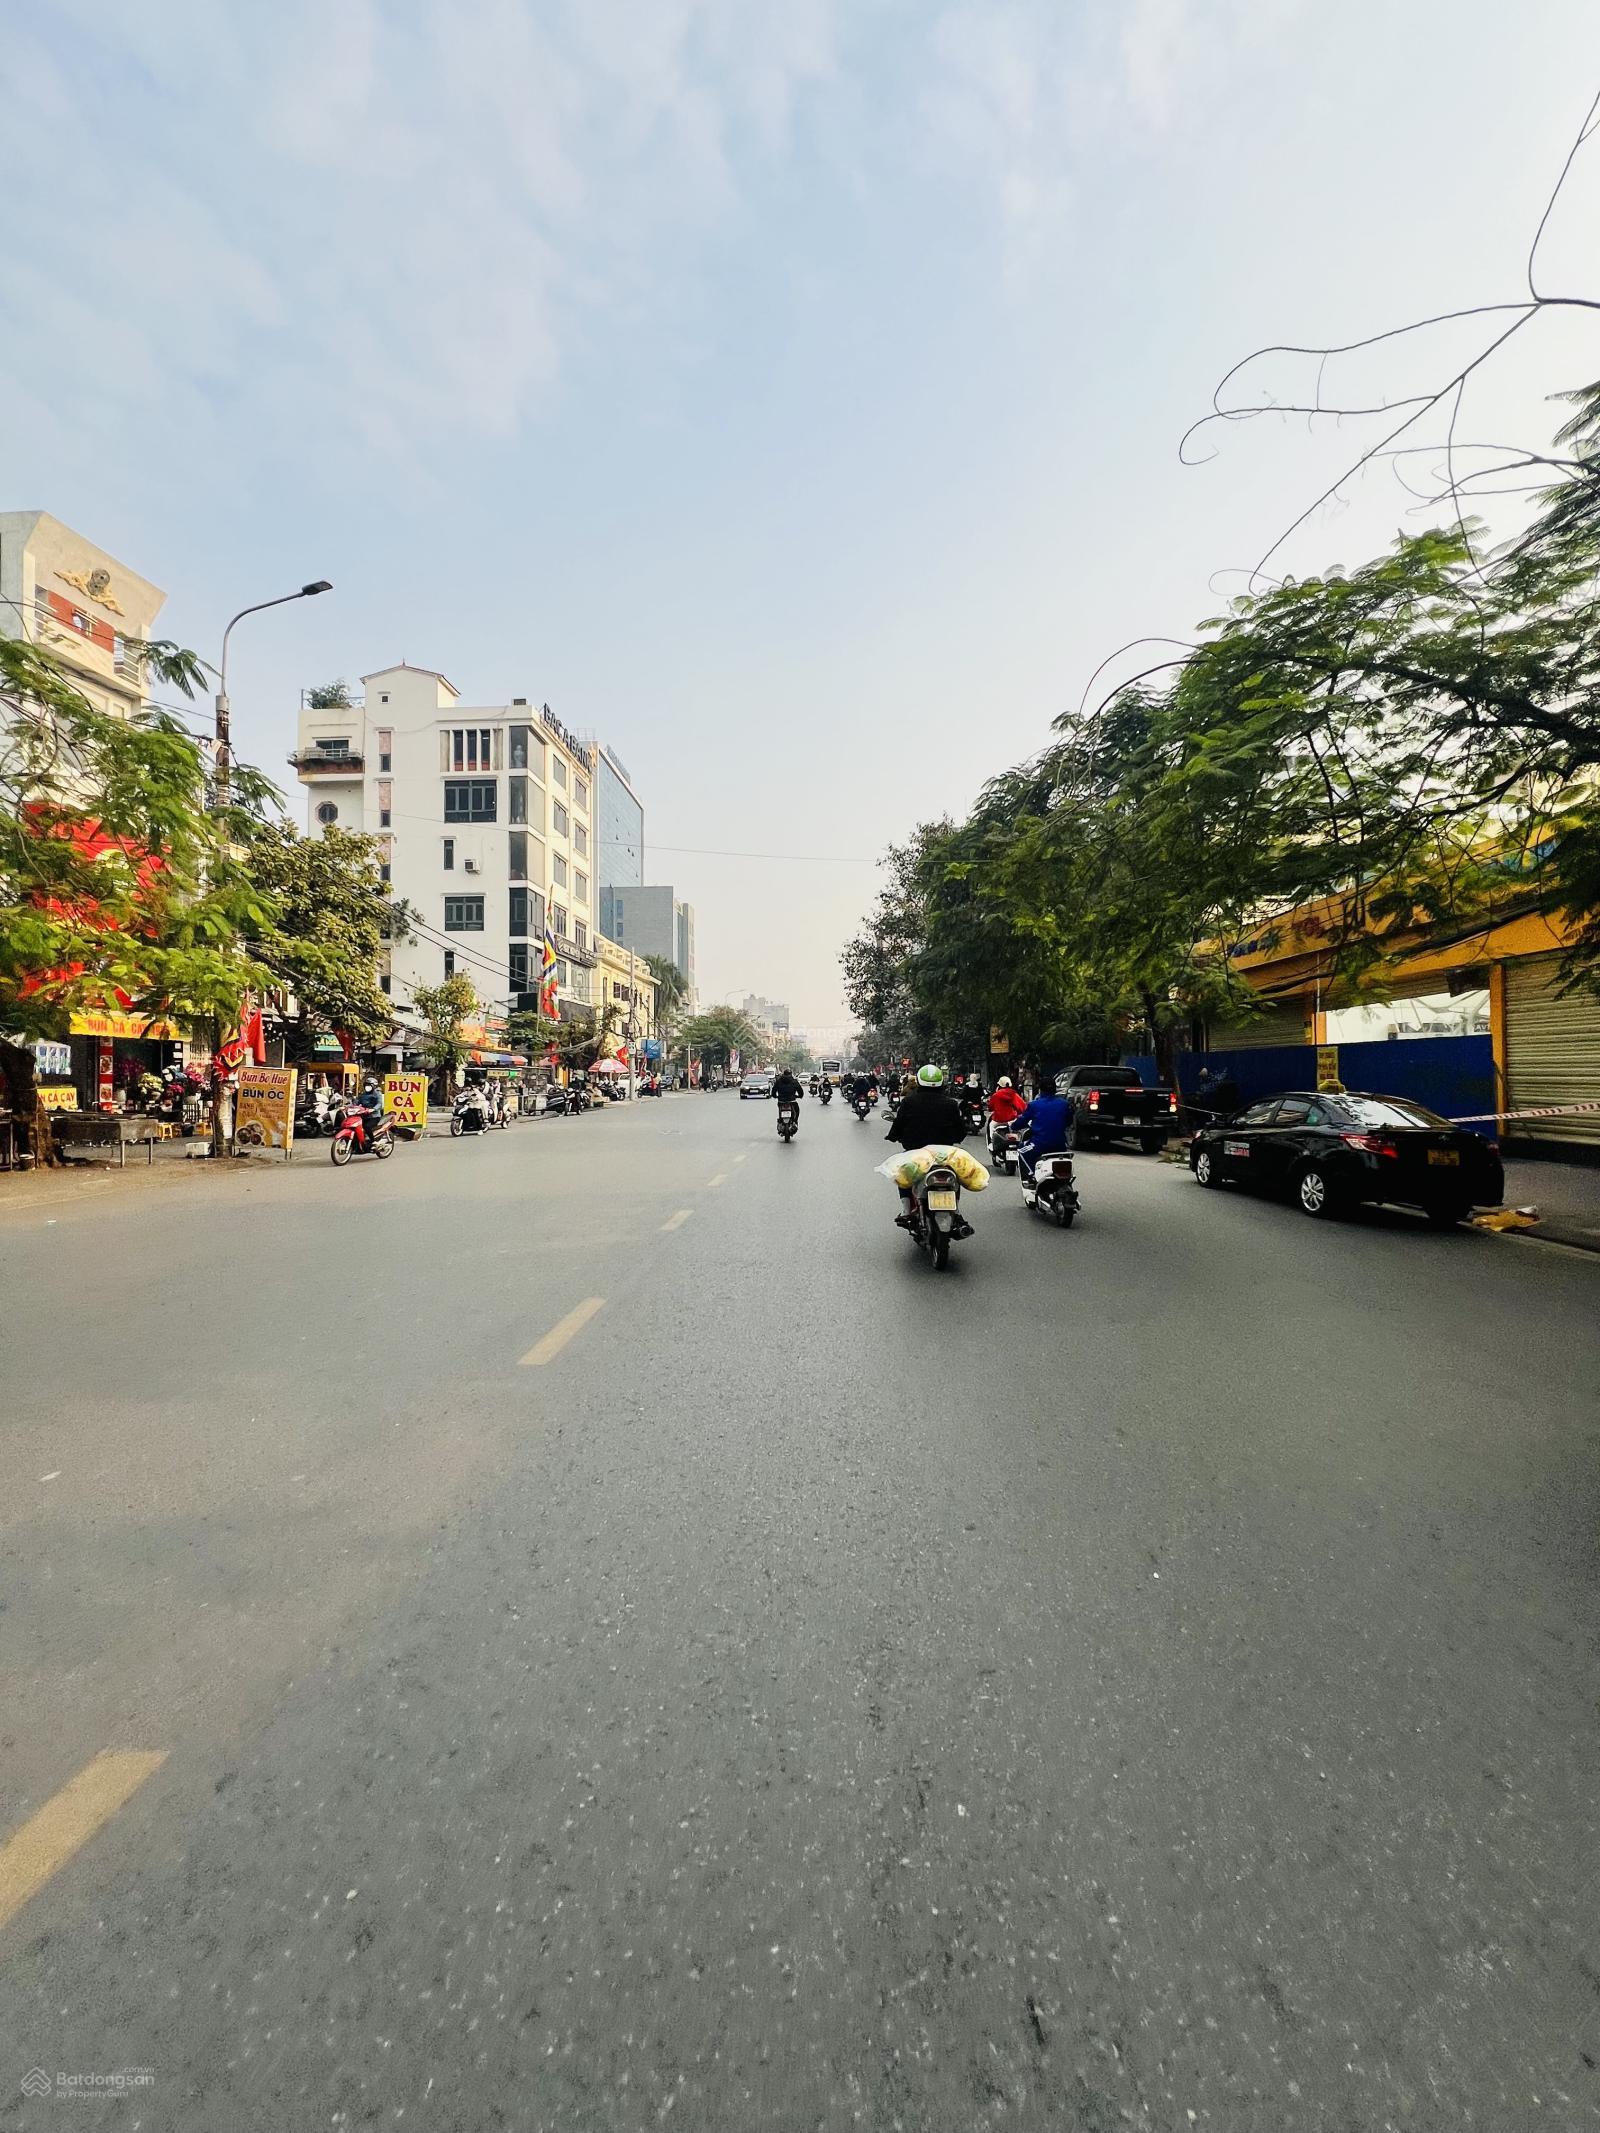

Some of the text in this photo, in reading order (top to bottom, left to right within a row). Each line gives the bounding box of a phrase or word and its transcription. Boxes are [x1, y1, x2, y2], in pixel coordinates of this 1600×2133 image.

[388, 1078, 421, 1092] BÚN
[242, 1086, 264, 1099] BÚN
[393, 1094, 415, 1107] CÁ
